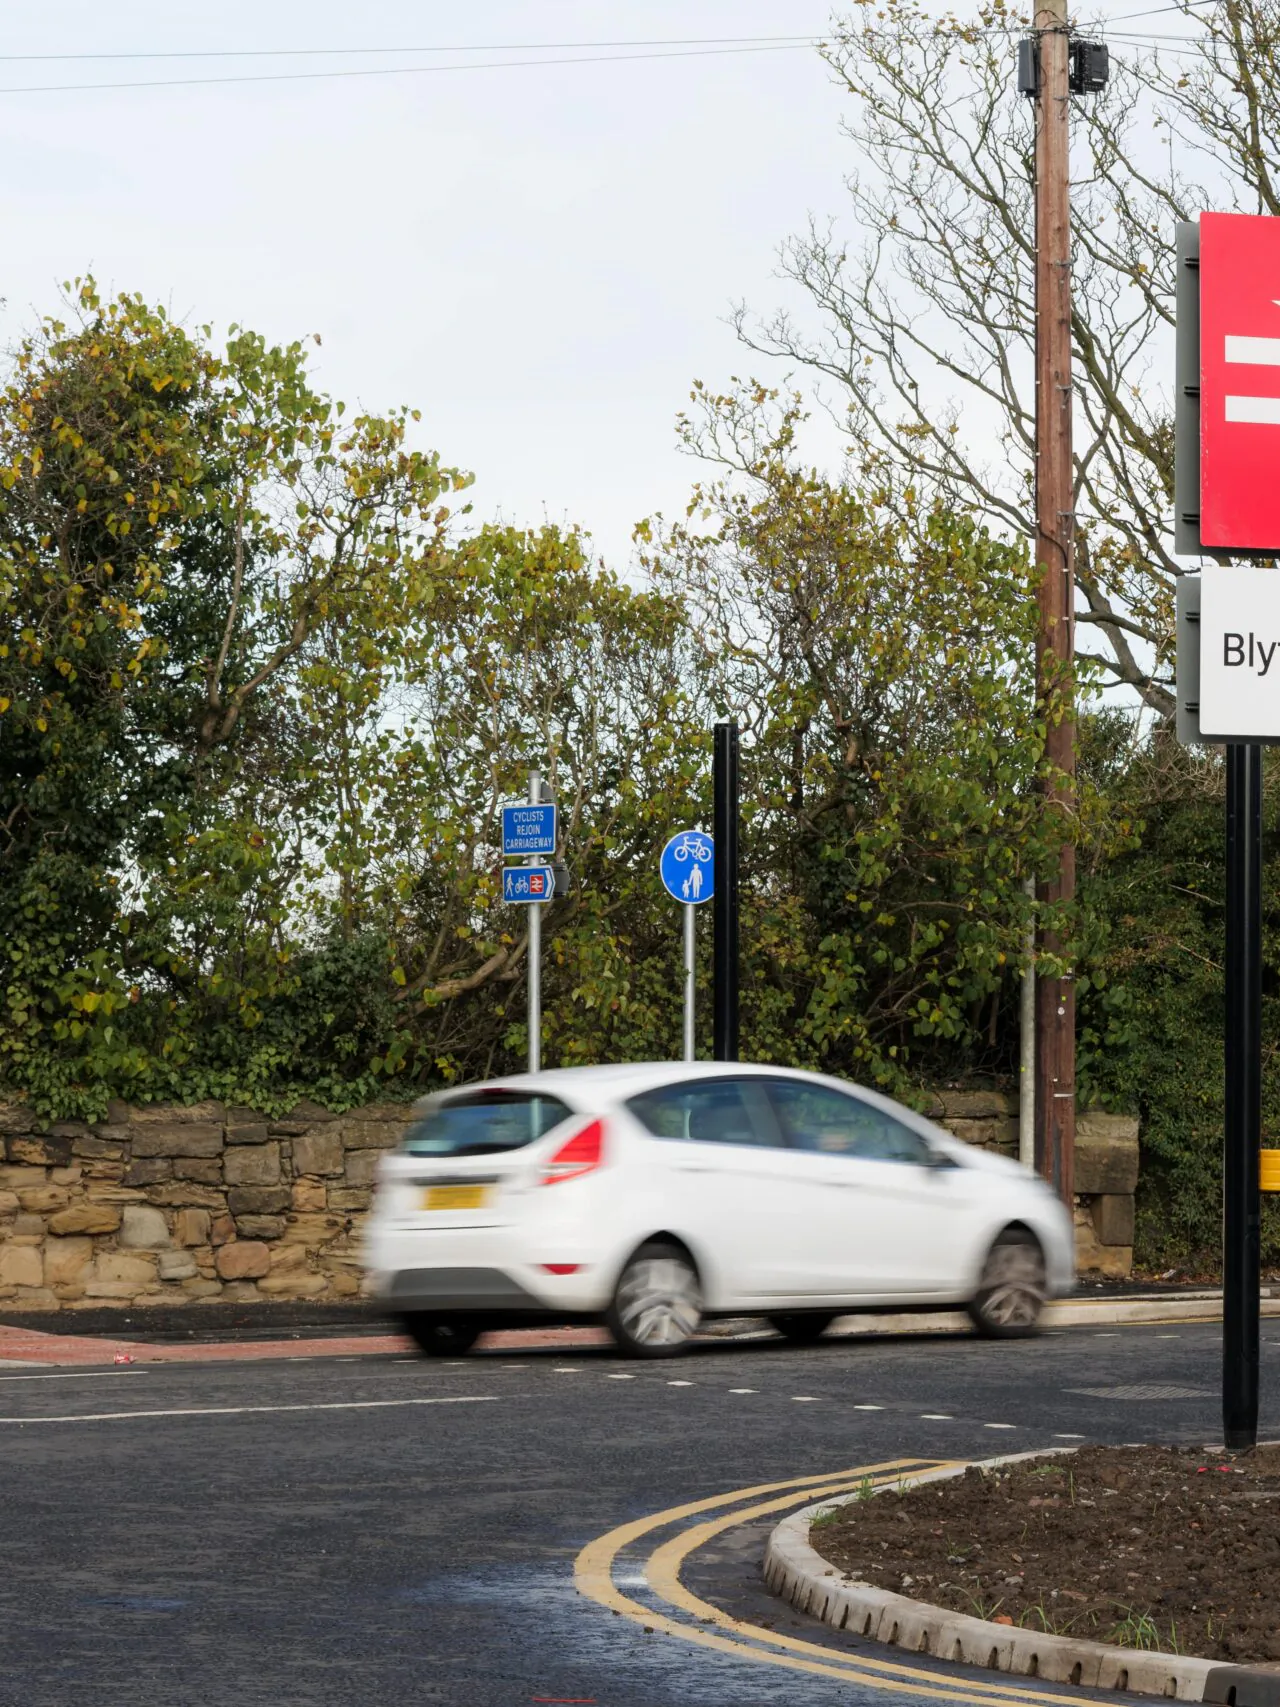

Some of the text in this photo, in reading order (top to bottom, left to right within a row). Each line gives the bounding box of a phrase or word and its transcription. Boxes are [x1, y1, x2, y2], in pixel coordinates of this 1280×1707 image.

[513, 810, 544, 822] CYCLISTS
[516, 824, 541, 836] REJOIN
[505, 837, 553, 850] CARRIAGEWAY
